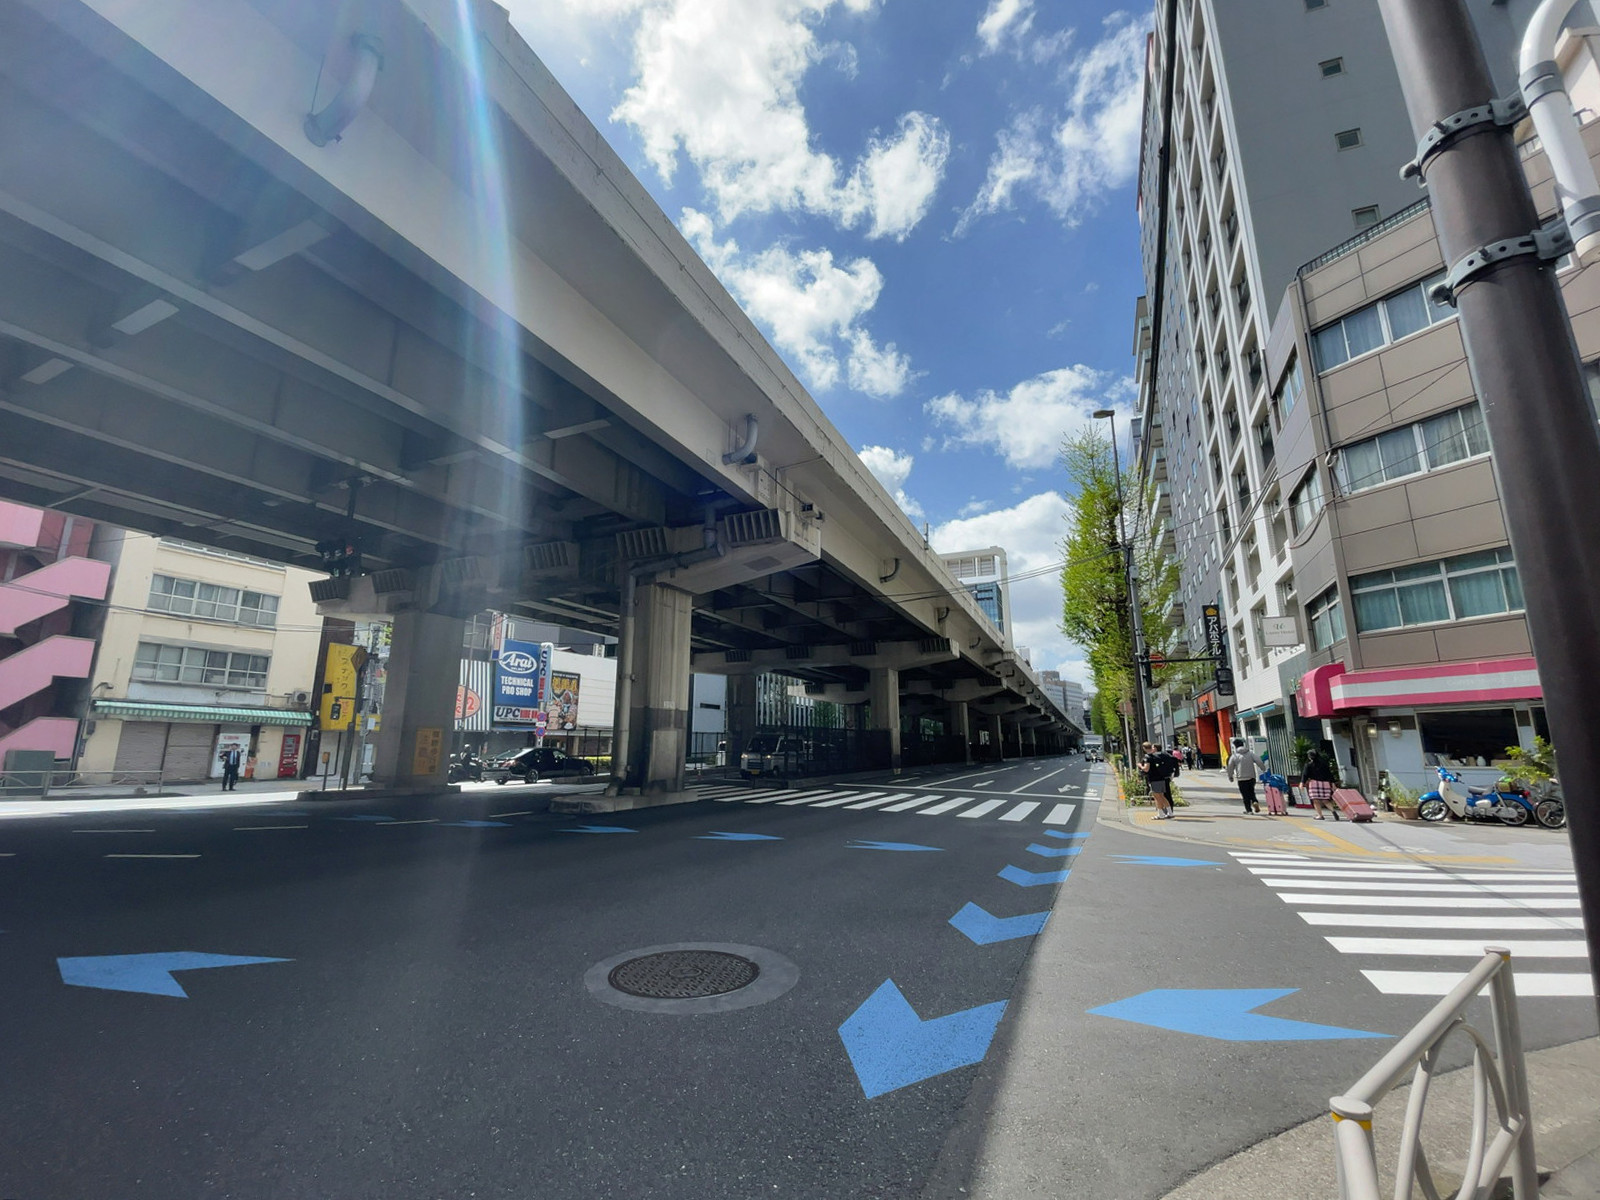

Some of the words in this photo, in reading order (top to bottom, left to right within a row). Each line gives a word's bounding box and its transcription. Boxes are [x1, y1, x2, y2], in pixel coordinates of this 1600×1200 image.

[503, 653, 532, 668] Arai
[540, 650, 548, 677] UPC
[501, 676, 534, 687] TECHNICAL
[502, 686, 514, 695] PRO
[516, 687, 533, 697] SHOP
[495, 706, 521, 718] UPC
